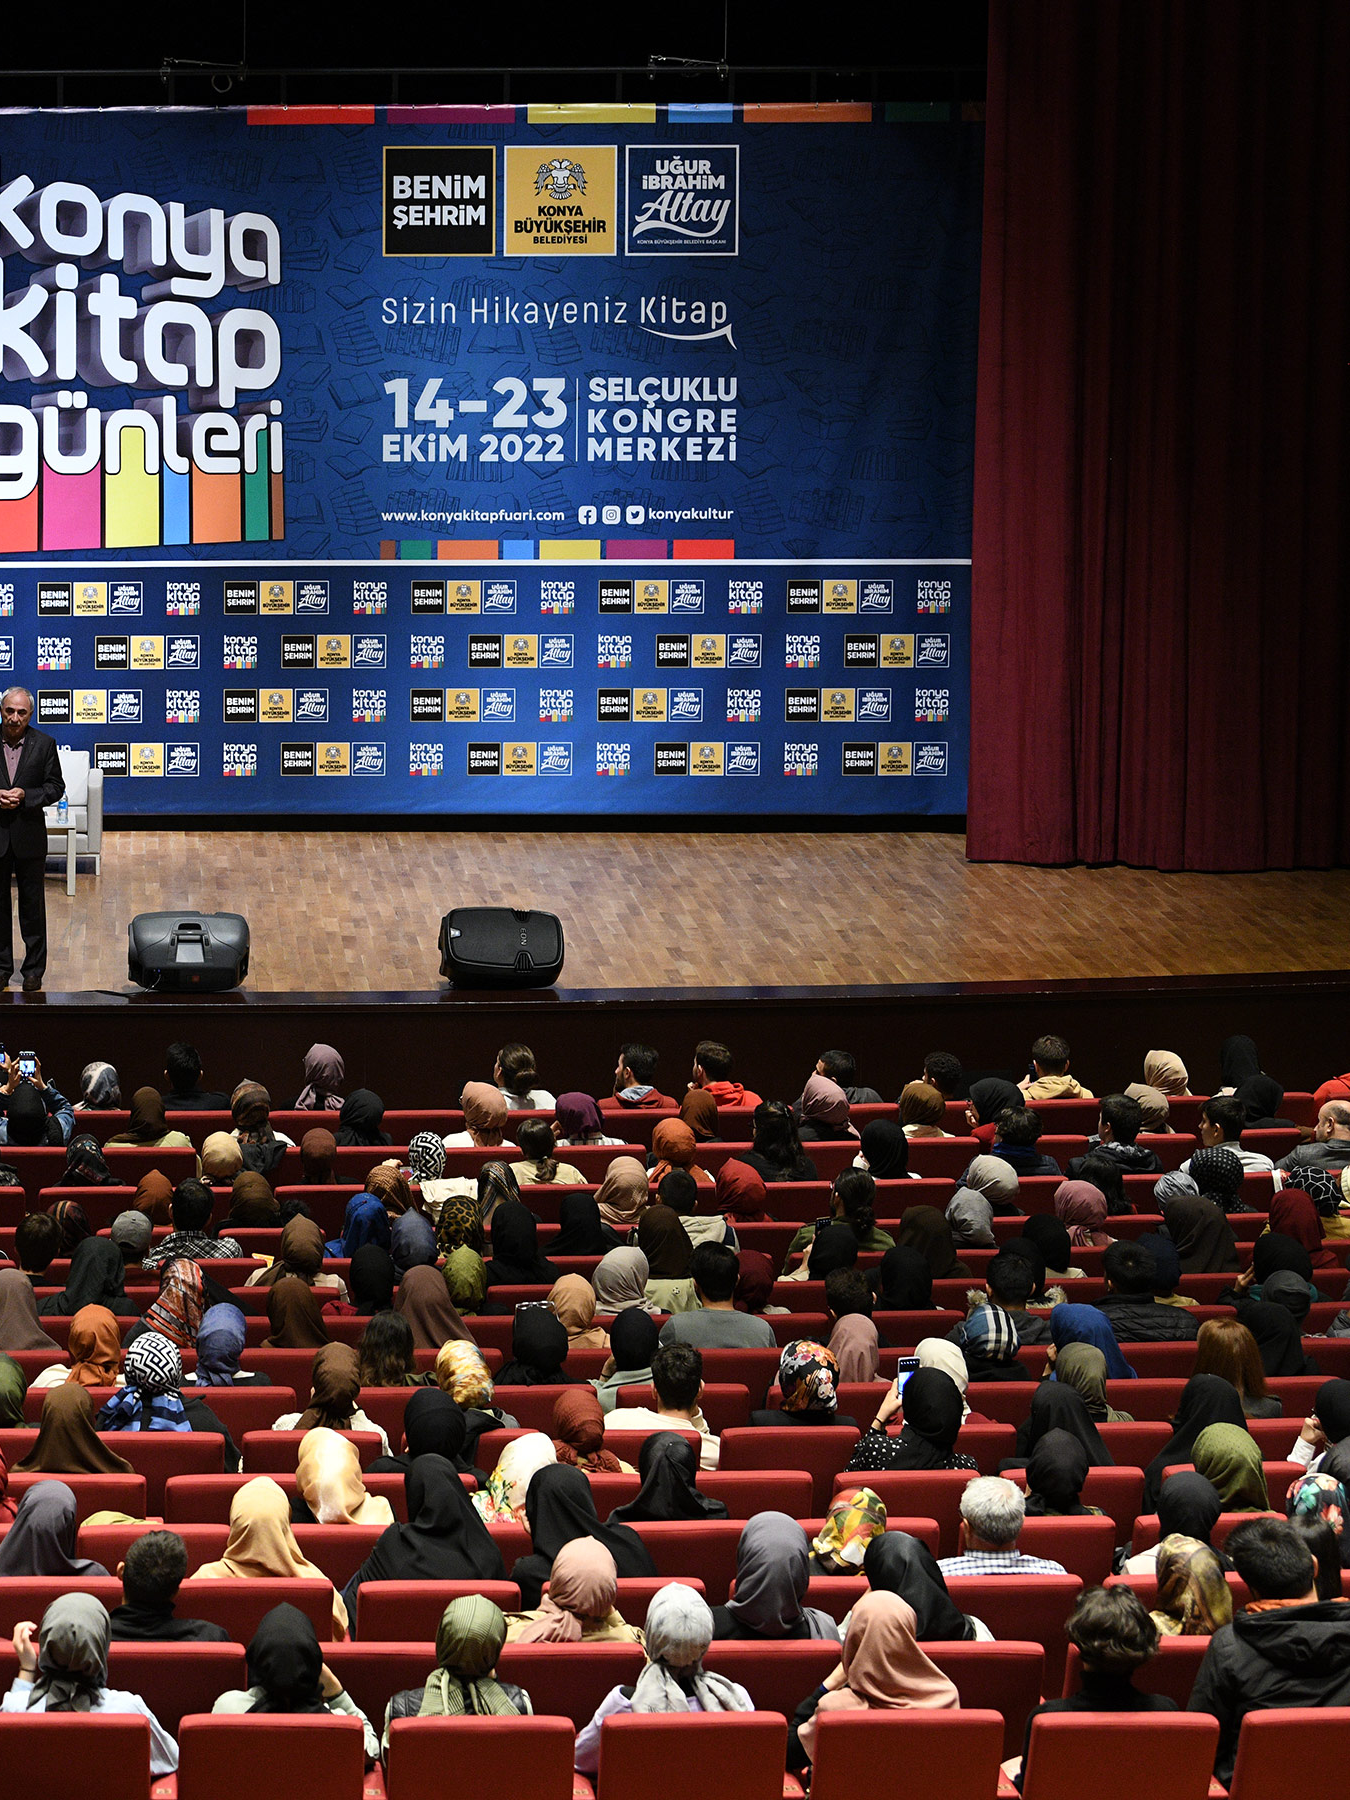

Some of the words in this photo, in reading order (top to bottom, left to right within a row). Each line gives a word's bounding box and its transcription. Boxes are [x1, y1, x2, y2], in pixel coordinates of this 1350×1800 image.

[655, 155, 711, 175] UĞUR
[537, 205, 583, 217] KONYA
[632, 190, 731, 238] Altay
[514, 217, 607, 236] BÜYÜKŞEHİR
[533, 233, 588, 244] BELEDİYESİ
[381, 296, 456, 324] Sizin
[471, 296, 628, 330] Hikayeniz
[640, 295, 728, 330] Kitap
[588, 376, 738, 408] SELÇUKLU
[384, 376, 568, 429] 14-23
[588, 408, 738, 433] KONGRE
[479, 434, 565, 462] 2022
[381, 508, 565, 525] www.konyakitapfuari.com
[648, 507, 734, 524] konyakultur
[167, 581, 200, 592] konya
[541, 580, 574, 591] konya
[167, 590, 200, 601] kitap
[541, 589, 574, 600] kitap
[38, 636, 71, 647] konya
[224, 635, 257, 646] konya
[411, 634, 444, 645] konya
[786, 634, 820, 645] konya
[38, 645, 71, 656] kitap
[224, 644, 257, 655] kitap
[411, 643, 444, 654] kitap
[786, 643, 819, 654] kitap
[166, 689, 199, 700] konya
[353, 688, 386, 699] konya
[540, 688, 573, 699] konya
[916, 688, 949, 699] konya
[166, 698, 199, 709] kitap
[353, 697, 386, 708] kitap
[540, 697, 573, 708] kitap
[916, 697, 948, 708] kitap
[410, 742, 443, 753] konya
[785, 742, 818, 753] konya
[410, 751, 443, 762] kitap
[785, 751, 817, 762] kitap
[520, 927, 528, 946] EON
